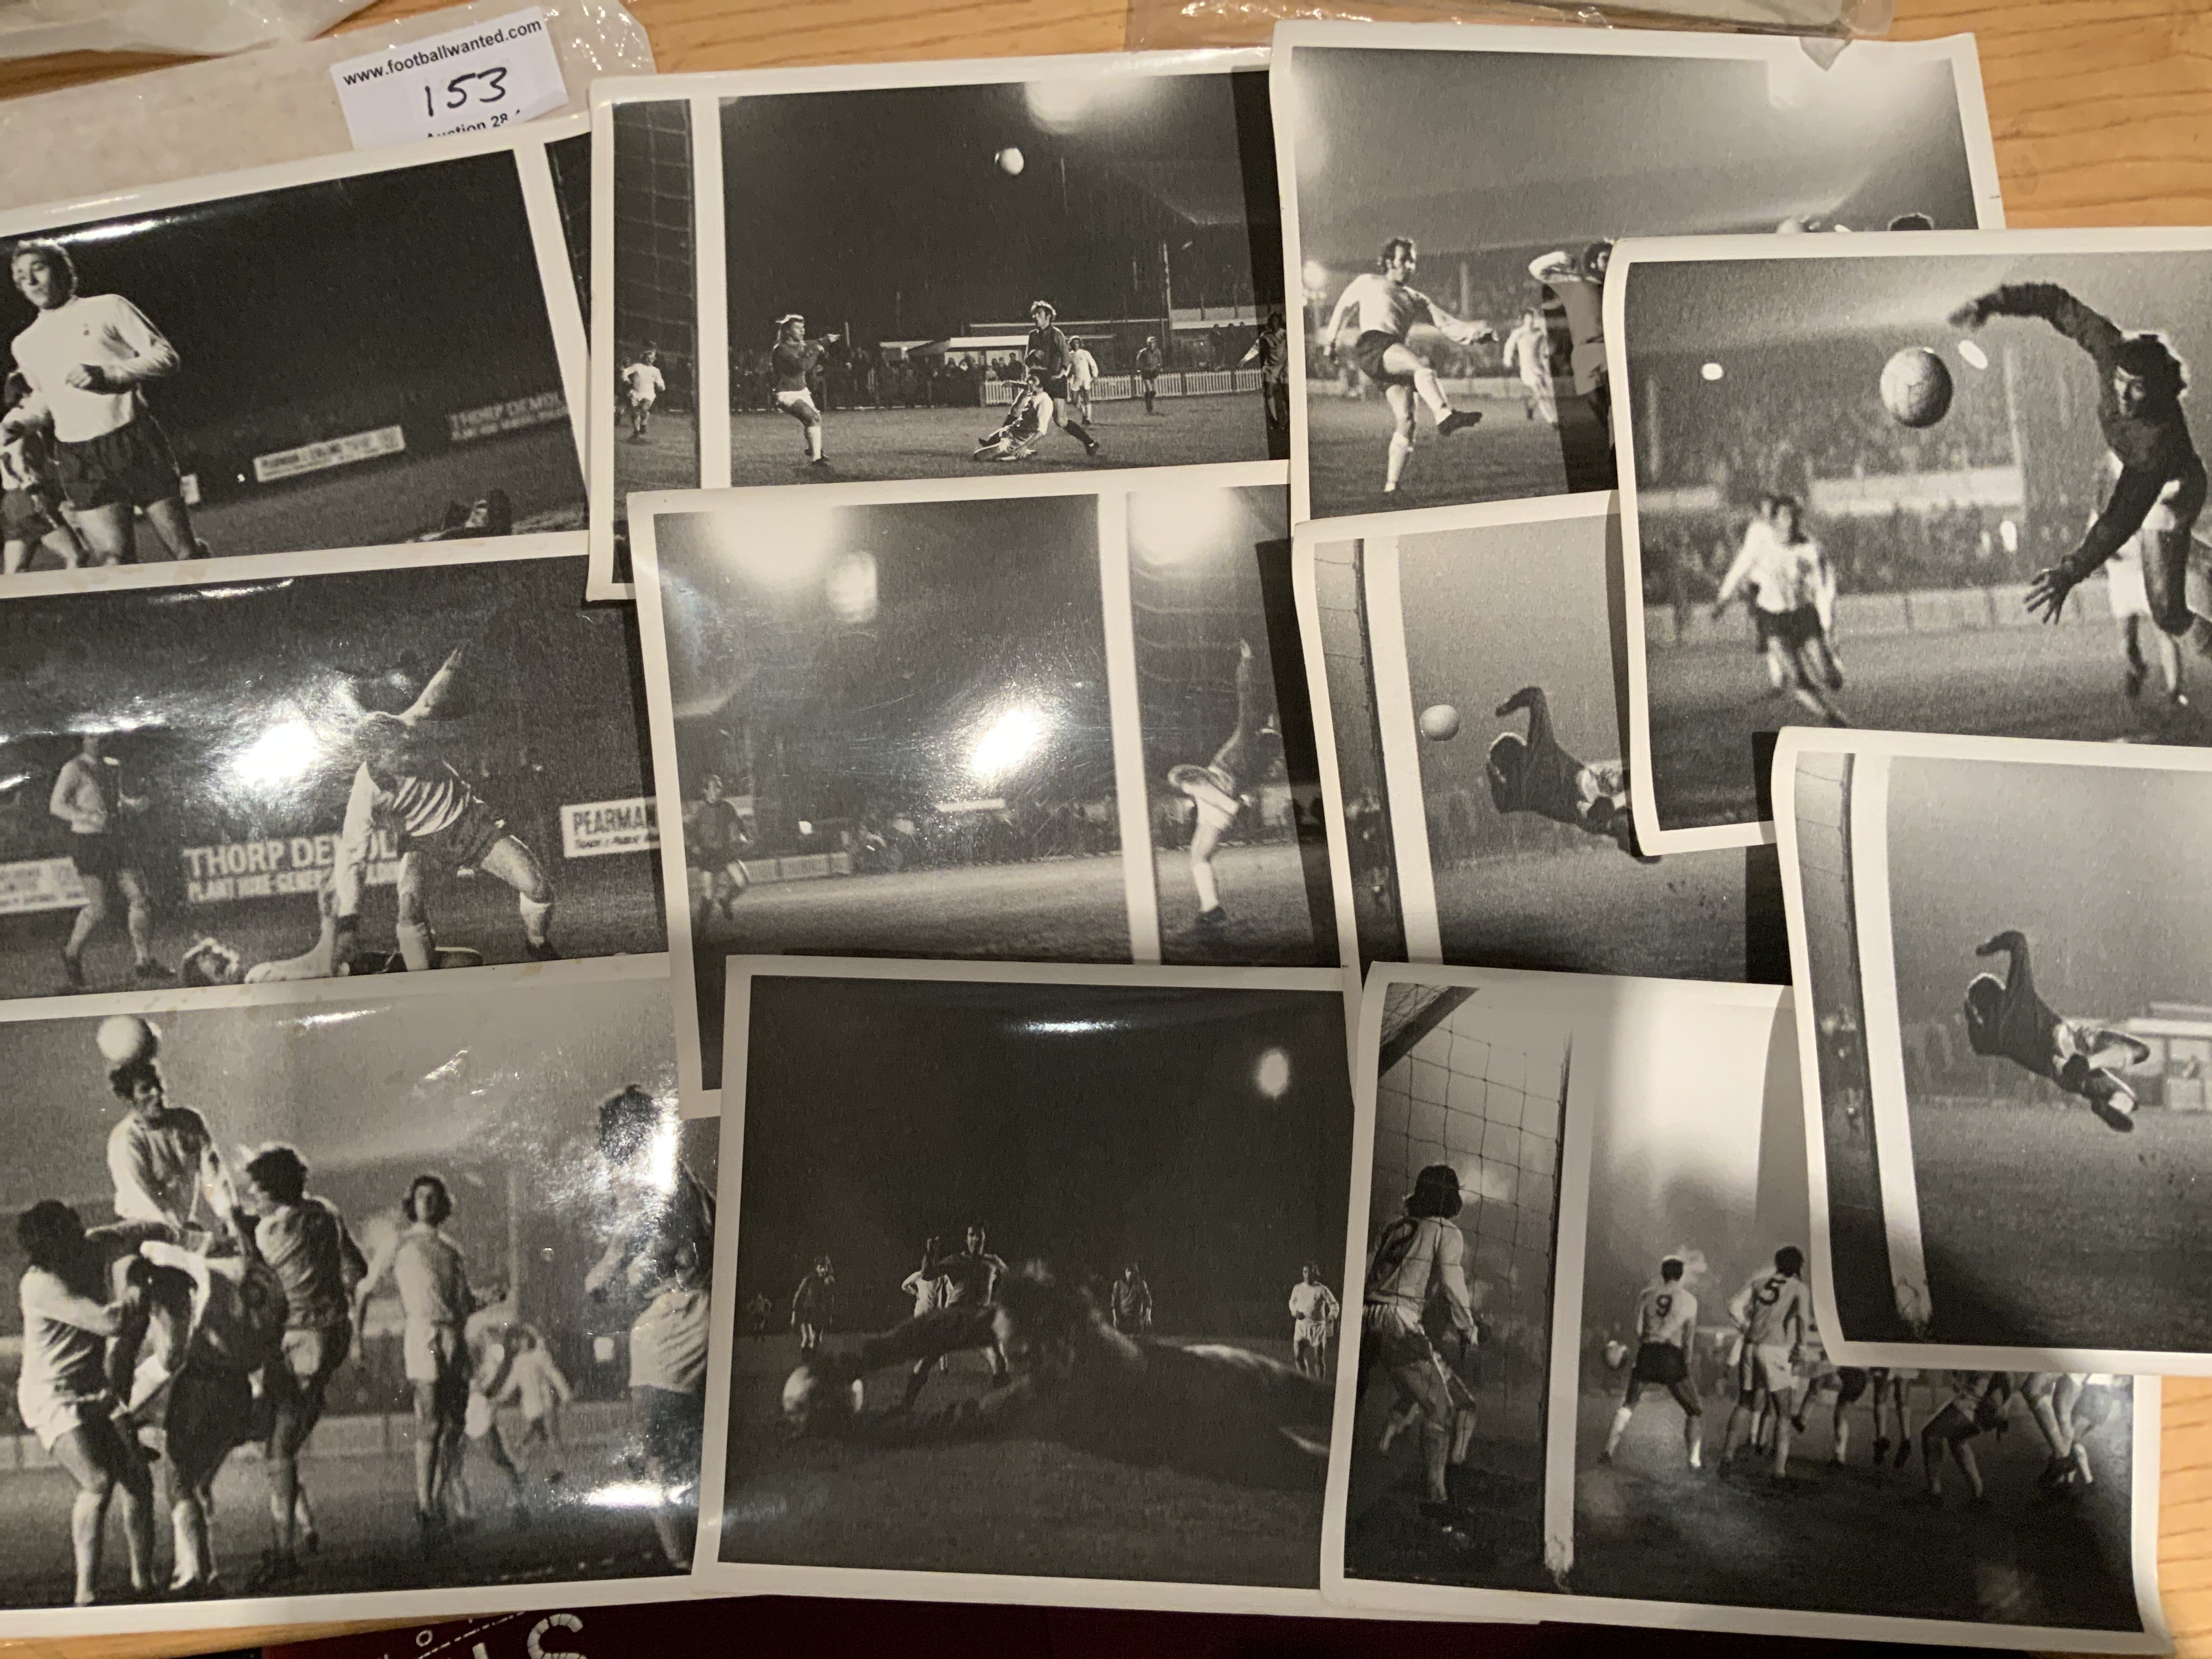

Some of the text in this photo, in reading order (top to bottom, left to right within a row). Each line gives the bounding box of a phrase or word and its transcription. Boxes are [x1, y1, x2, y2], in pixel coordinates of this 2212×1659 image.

[343, 20, 542, 85] www.footballwanted.com
[425, 67, 507, 117] 153
[182, 839, 284, 877] THORP
[1656, 1293, 1673, 1317] 9
[1757, 1277, 1786, 1305] 5
